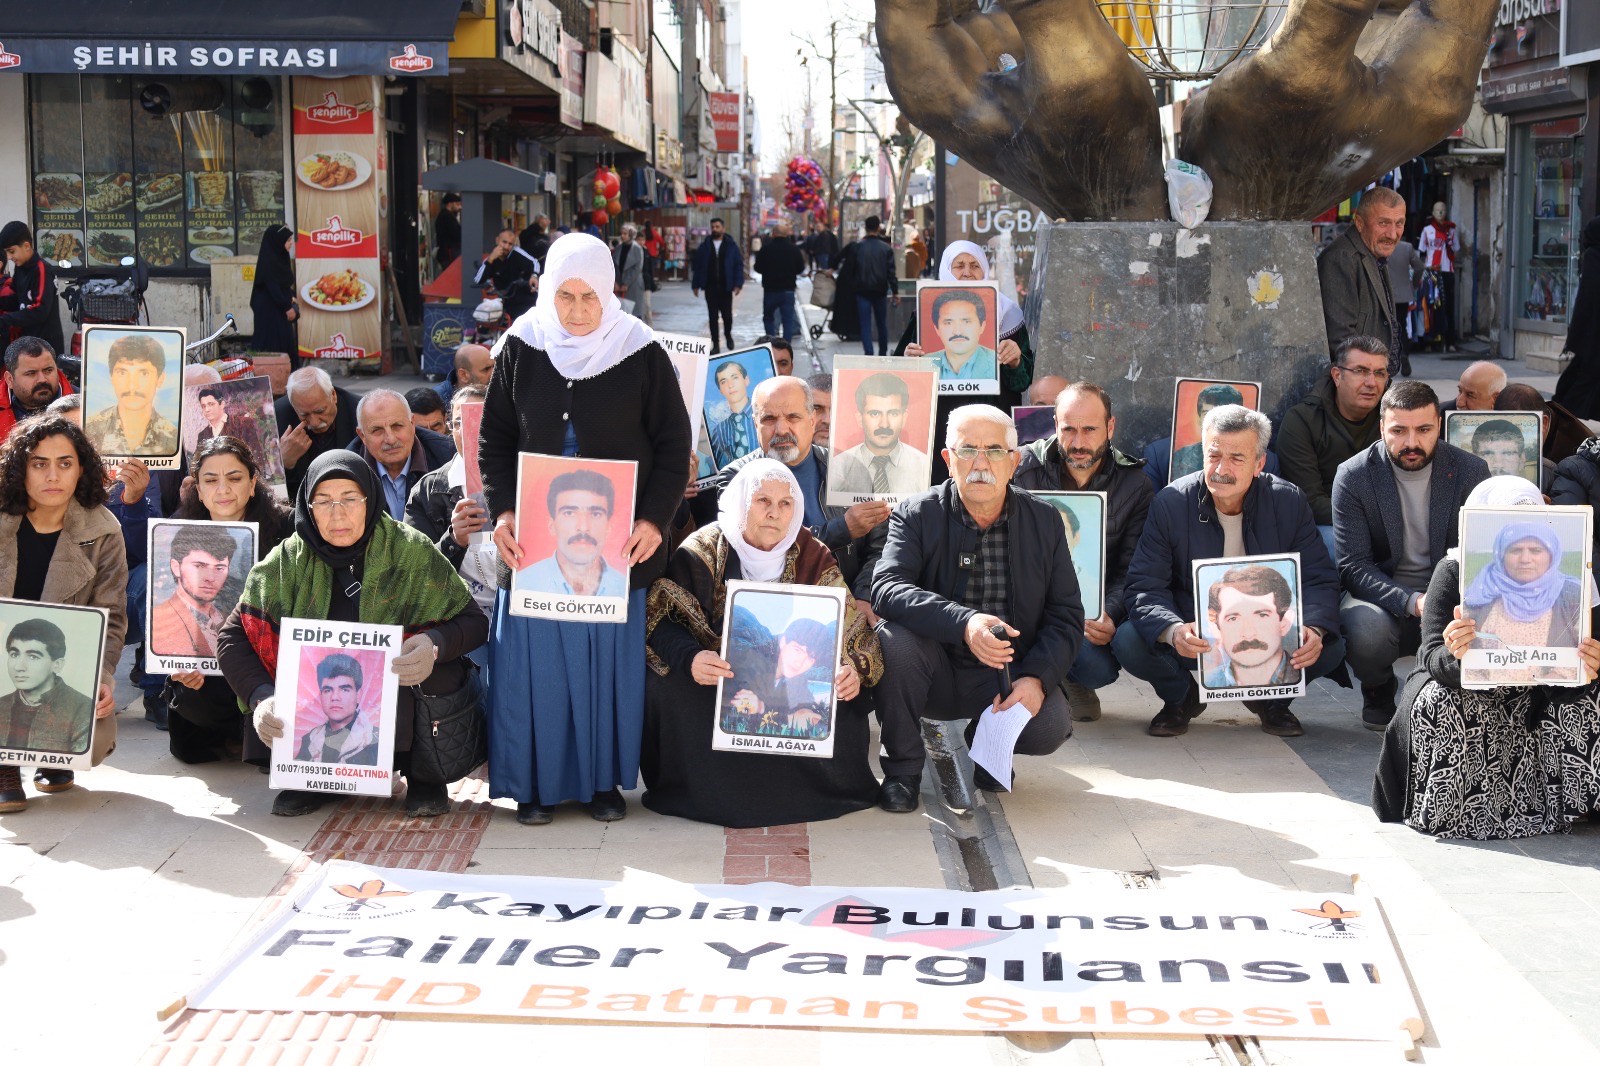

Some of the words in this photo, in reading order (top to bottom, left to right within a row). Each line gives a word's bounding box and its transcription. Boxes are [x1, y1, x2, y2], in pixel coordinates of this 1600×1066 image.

[73, 43, 177, 70] ŞEHİR
[190, 47, 338, 68] SOFRASI
[394, 57, 427, 68] şenpiliç
[312, 107, 352, 119] şenpiliç
[43, 213, 75, 221] ŞEHİR
[144, 213, 176, 221] ŞEHİR
[194, 211, 227, 219] ŞEHİR
[244, 211, 276, 219] ŞEHİR
[956, 205, 1049, 233] TUĞBA
[316, 230, 356, 243] şenpiliç
[676, 341, 706, 355] ÇELİK
[957, 382, 980, 391] GÖK
[144, 459, 173, 467] BULUT
[523, 597, 552, 611] Eset
[556, 599, 616, 615] GÖKTAYI
[292, 627, 333, 642] EDİP
[338, 630, 391, 648] ÇELİK
[159, 659, 198, 669] Yılmaz
[1486, 649, 1528, 667] Taybet
[1530, 649, 1557, 661] Ana
[1206, 690, 1244, 700] Medeni
[1247, 686, 1300, 697] GÖKTEPE
[731, 735, 773, 748] İSMAİL
[776, 739, 816, 751] AĞAYA
[0, 751, 36, 762] ÇETİN
[40, 754, 73, 765] ABAY
[335, 766, 389, 779] GÖZALTINDA
[306, 780, 357, 791] KAYBEDİLDİ
[433, 892, 803, 925] Kayıplar
[832, 904, 1269, 931] Bulunsun
[262, 928, 664, 970] Failler
[296, 968, 481, 1007] İHD
[518, 984, 919, 1020] Batman
[963, 996, 1331, 1028] Şubesi
